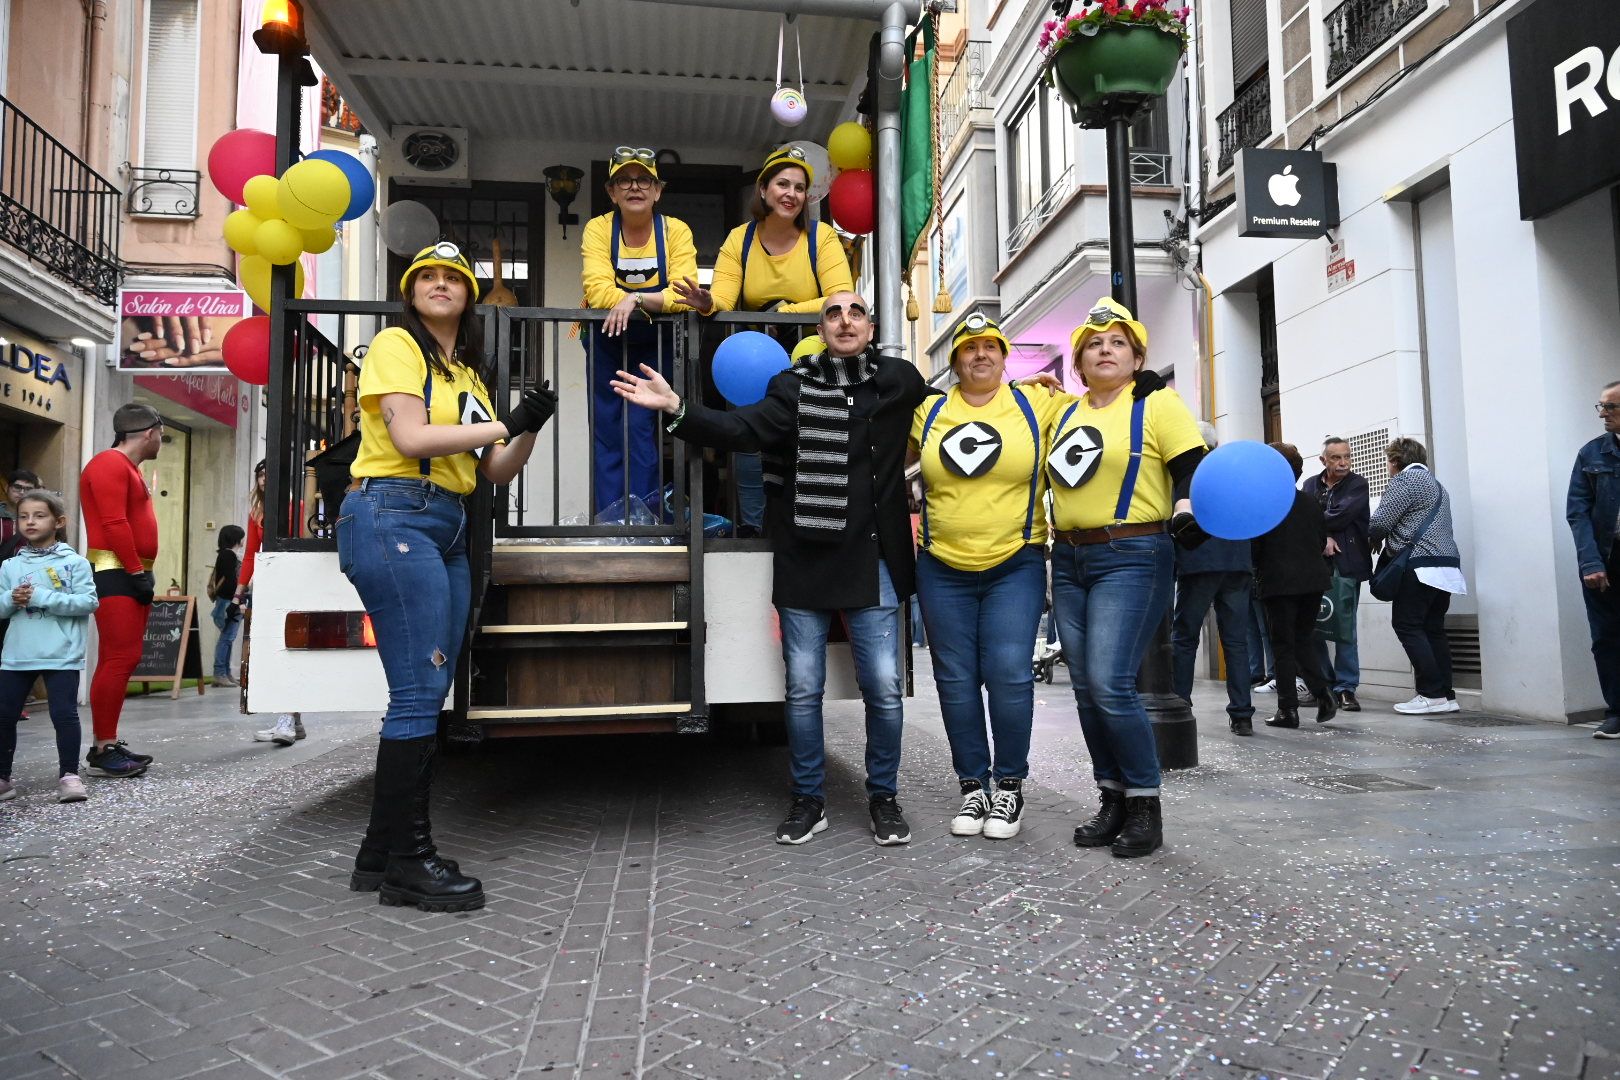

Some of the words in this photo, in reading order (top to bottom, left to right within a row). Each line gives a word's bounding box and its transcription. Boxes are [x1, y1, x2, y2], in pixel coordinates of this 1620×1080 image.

[1252, 216, 1288, 226] Premium
[1290, 217, 1320, 227] Reseller
[125, 294, 173, 315] Salón
[175, 297, 195, 315] de
[197, 295, 241, 315] Uñas
[22, 389, 52, 412] 1946
